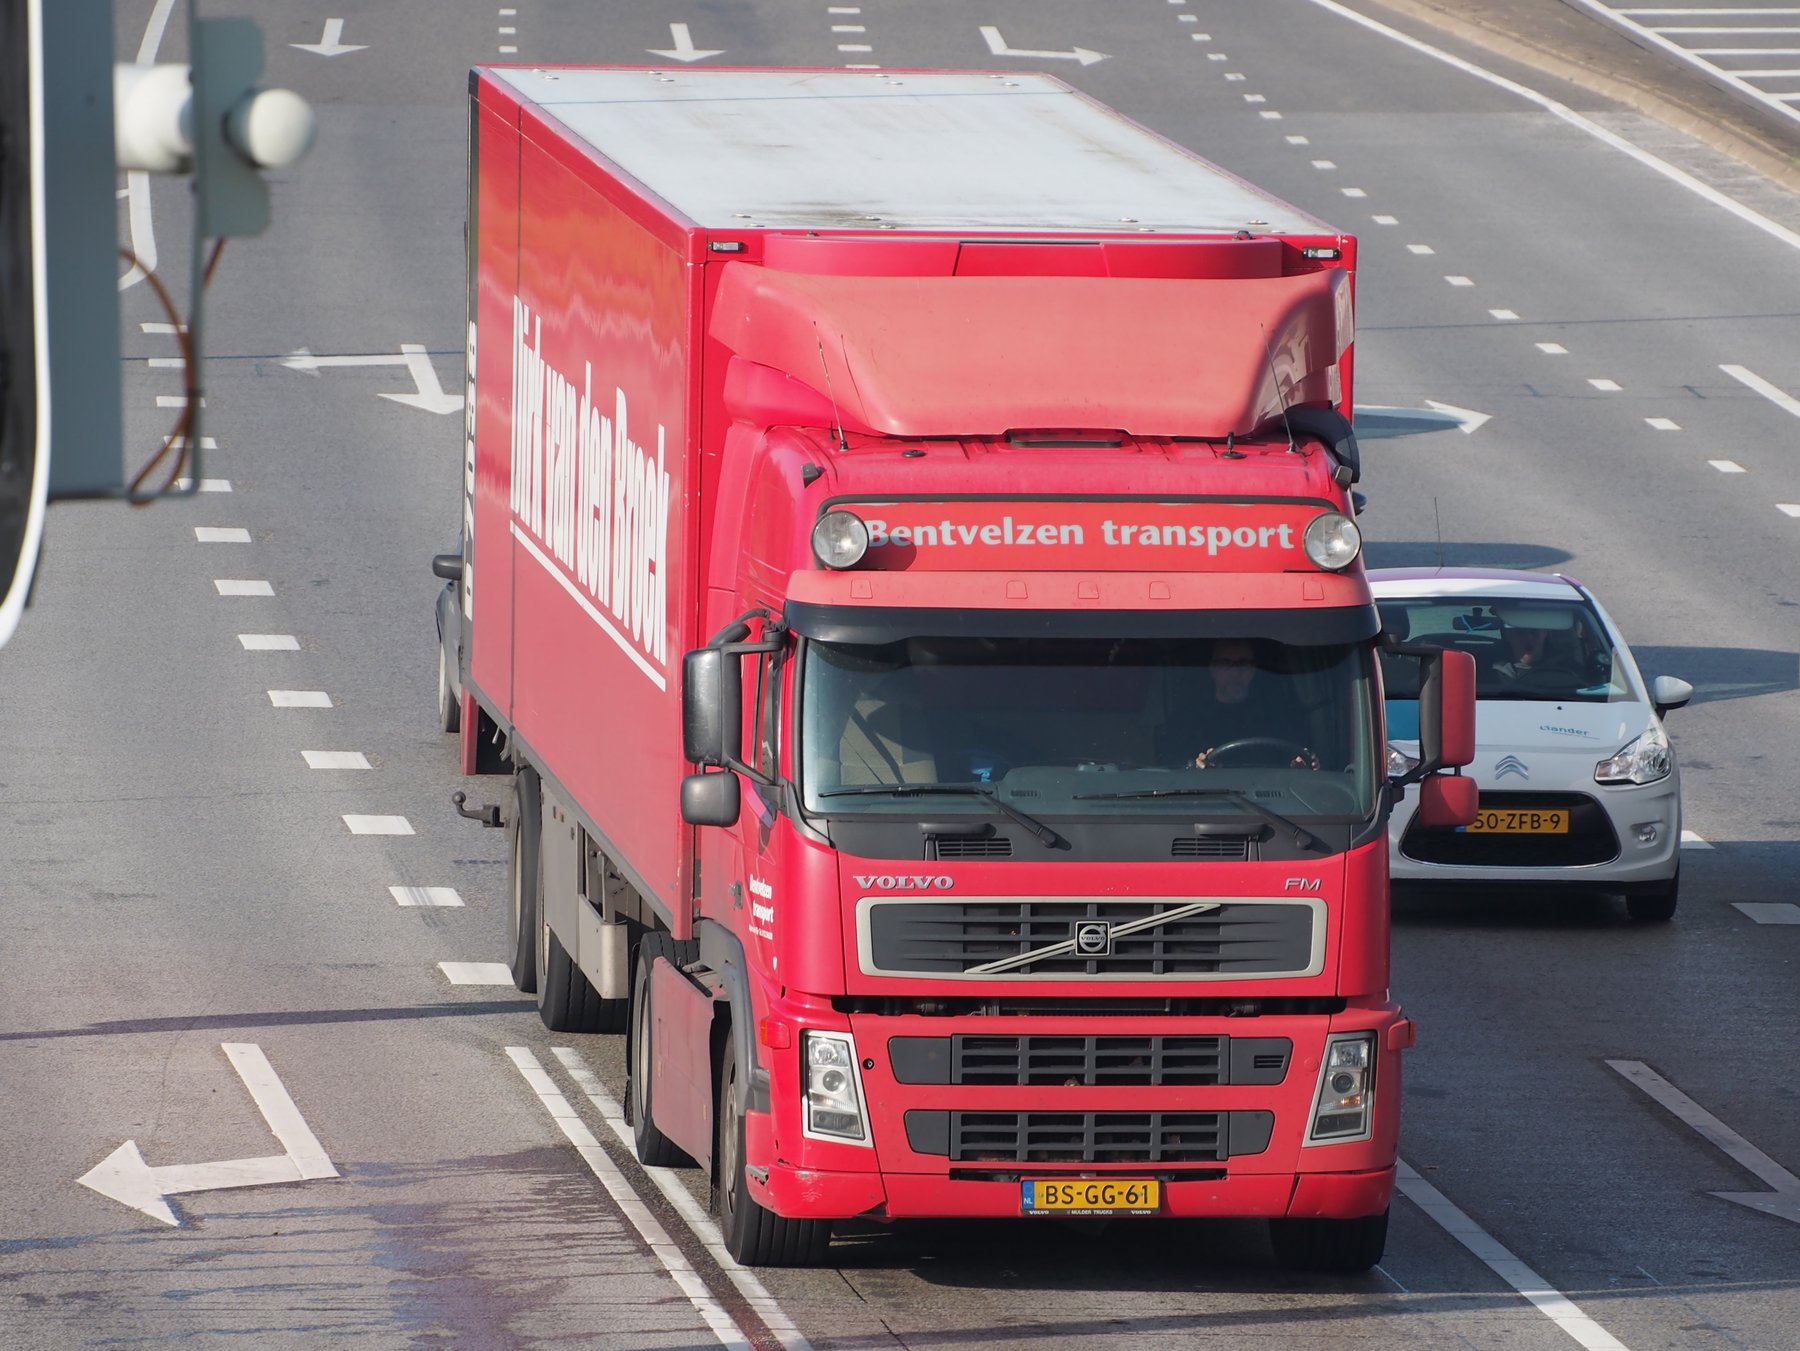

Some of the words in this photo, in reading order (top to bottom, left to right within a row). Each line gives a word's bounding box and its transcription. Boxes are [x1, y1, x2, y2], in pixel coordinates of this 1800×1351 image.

[510, 294, 544, 539] Dirk
[546, 364, 576, 572] van
[577, 359, 612, 609] den
[612, 386, 670, 667] Broek
[866, 516, 1084, 548] Bentvelzen
[1101, 519, 1294, 555] transport
[1474, 813, 1561, 830] 50-ZFB-9
[852, 875, 954, 890] VOLVO
[1284, 877, 1321, 892] FM
[1045, 1184, 1149, 1205] BS-GG-61
